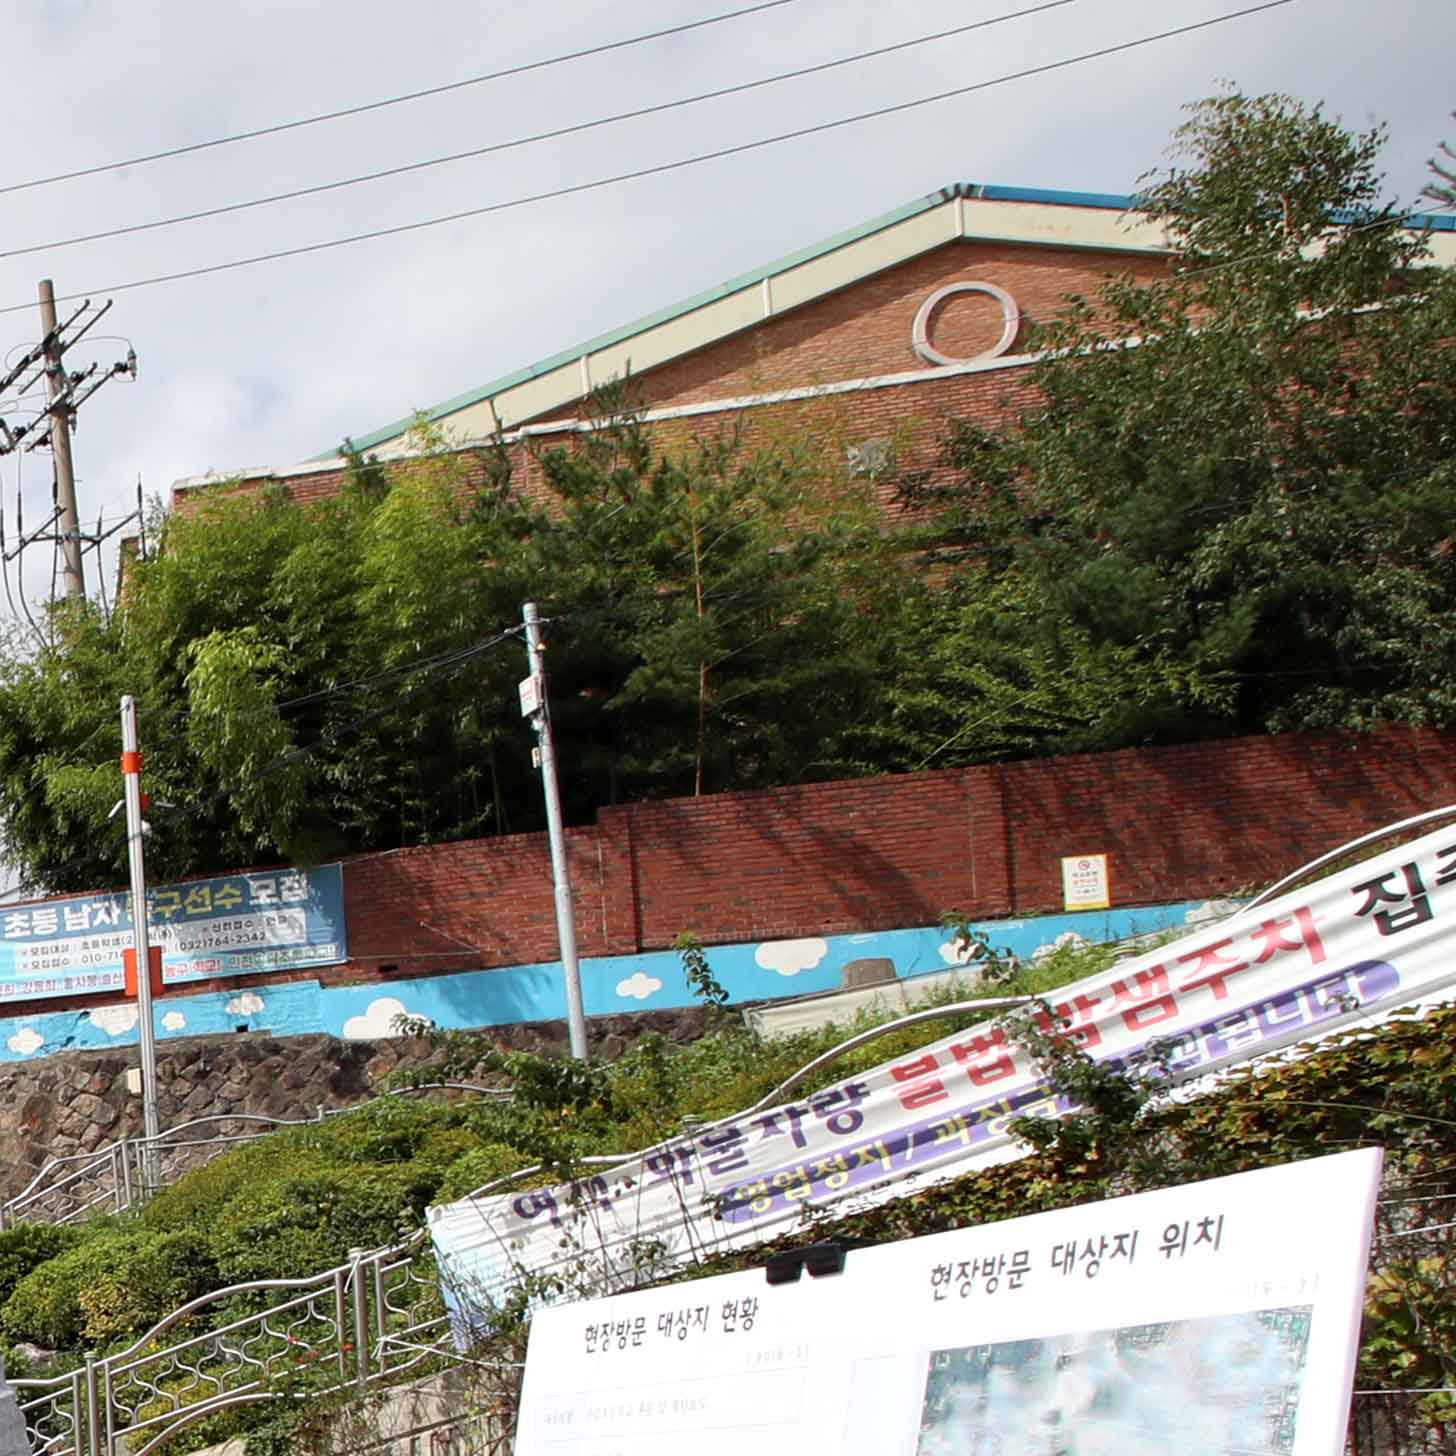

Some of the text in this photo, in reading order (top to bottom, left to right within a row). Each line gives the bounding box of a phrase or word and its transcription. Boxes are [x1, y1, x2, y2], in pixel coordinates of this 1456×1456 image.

[4, 908, 59, 938] 초등
[64, 901, 121, 932] 남자
[127, 884, 242, 922] 구선수
[1349, 845, 1456, 937] 집
[735, 1138, 892, 1214] 영업정지
[930, 1214, 1227, 1302] 현장방문 대상지 위치
[585, 1296, 760, 1354] 현장방문 대상지 현황
